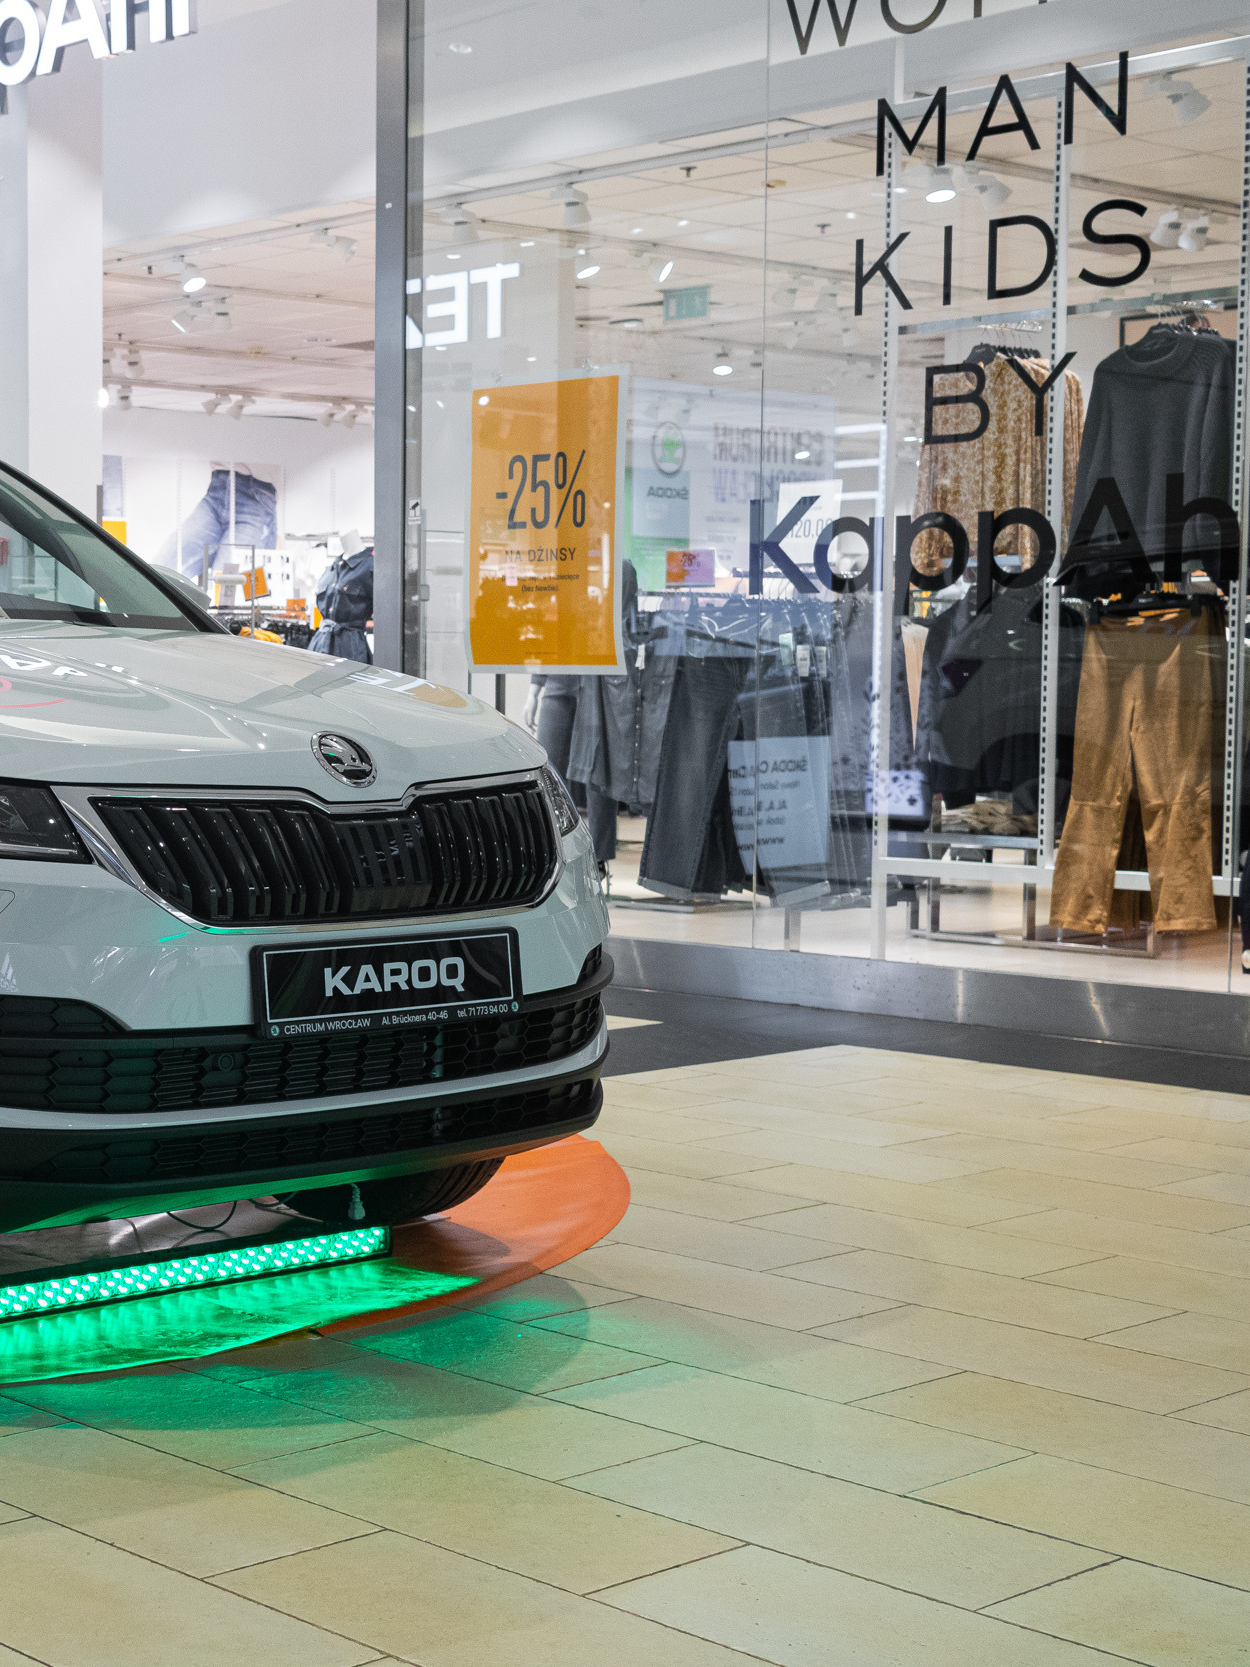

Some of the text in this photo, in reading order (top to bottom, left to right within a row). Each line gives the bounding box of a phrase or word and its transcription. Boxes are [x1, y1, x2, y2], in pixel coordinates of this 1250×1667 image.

[876, 51, 1129, 177] MAN
[854, 200, 1151, 316] KIDS
[924, 351, 1078, 446] BY
[495, 449, 586, 530] -25%
[505, 546, 577, 562] NA DŻINSY
[323, 956, 466, 997] KAROQ
[284, 1021, 326, 1035] CENTRUM
[326, 1018, 371, 1032] WROCŁAW
[391, 1013, 427, 1025] Brücknera
[427, 1011, 449, 1021] 40-46
[457, 1008, 468, 1018] tel.
[468, 1007, 476, 1017] 71
[476, 1006, 489, 1016] 773
[489, 1005, 499, 1015] 94
[499, 1003, 509, 1014] 00
